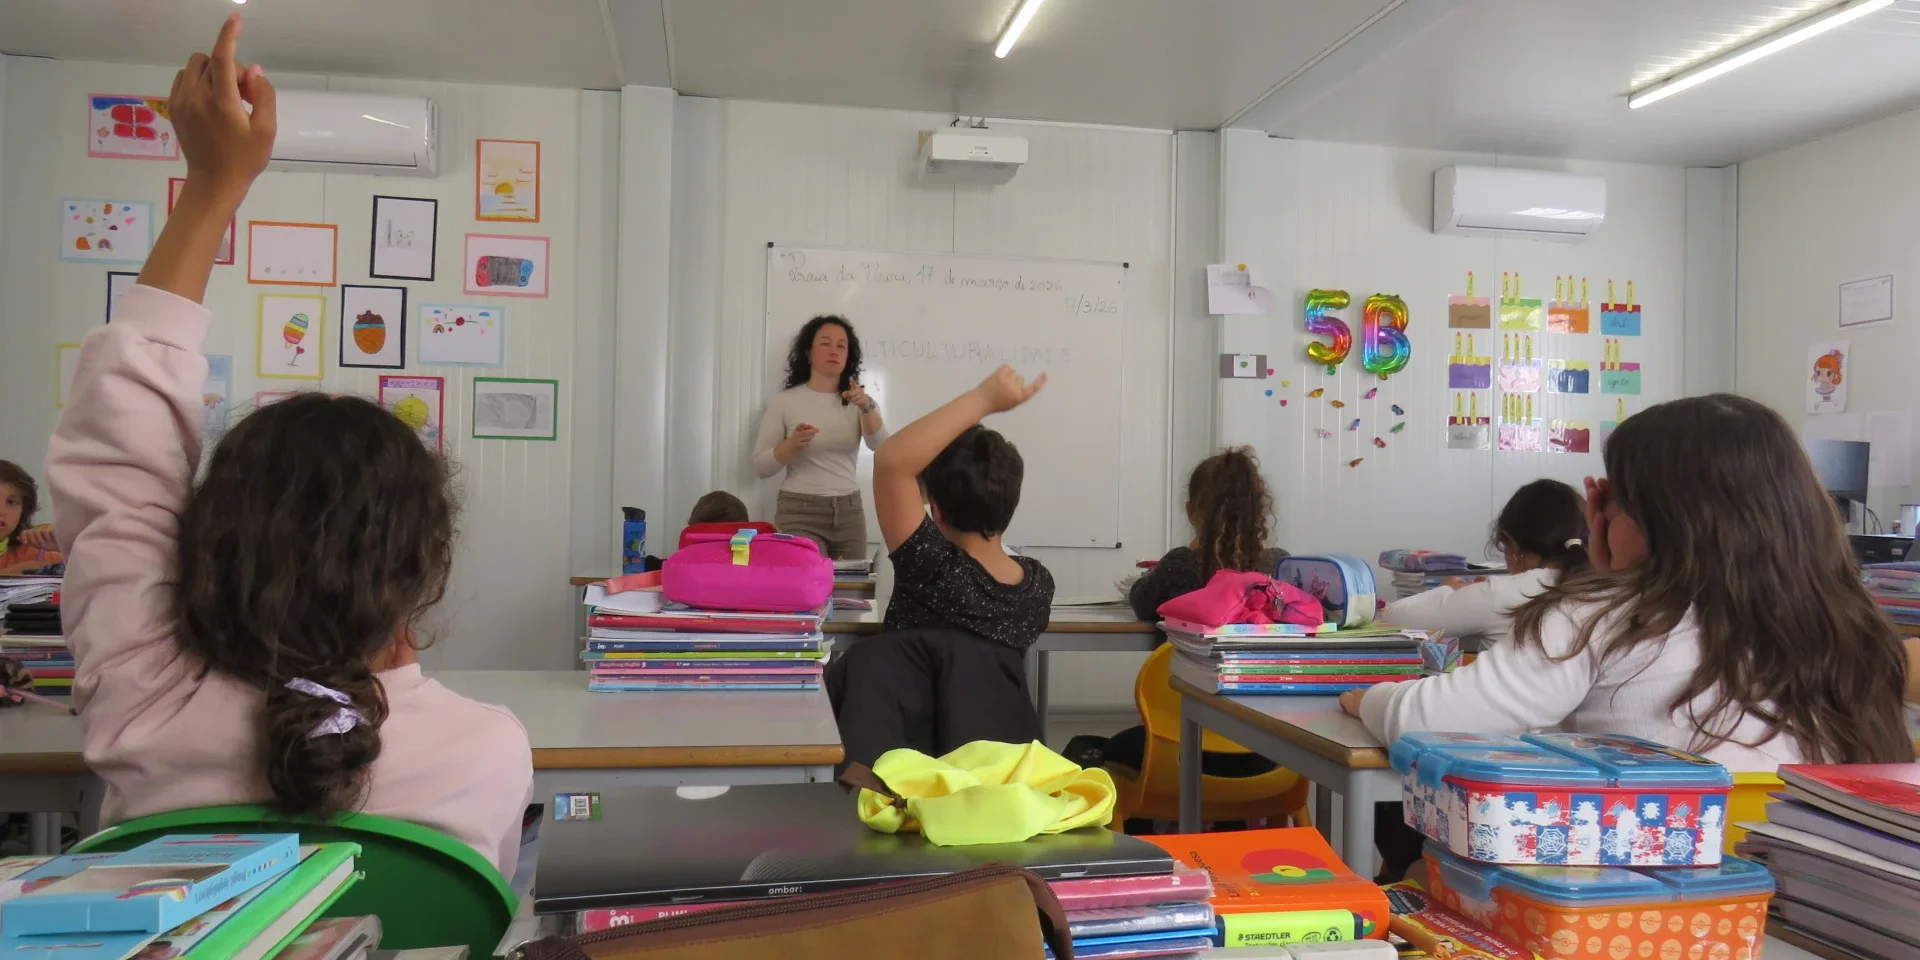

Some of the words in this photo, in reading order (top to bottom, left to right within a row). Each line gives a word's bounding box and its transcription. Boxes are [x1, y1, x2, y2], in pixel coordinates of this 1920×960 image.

[788, 251, 829, 283] Praia
[916, 264, 936, 286] 17
[944, 267, 956, 286] de
[960, 275, 1009, 292] março
[1014, 275, 1026, 292] de
[1030, 279, 1064, 292] 2026
[863, 340, 1075, 364] LTICULTURALIDADE
[1244, 932, 1291, 941] STAEDTLER
